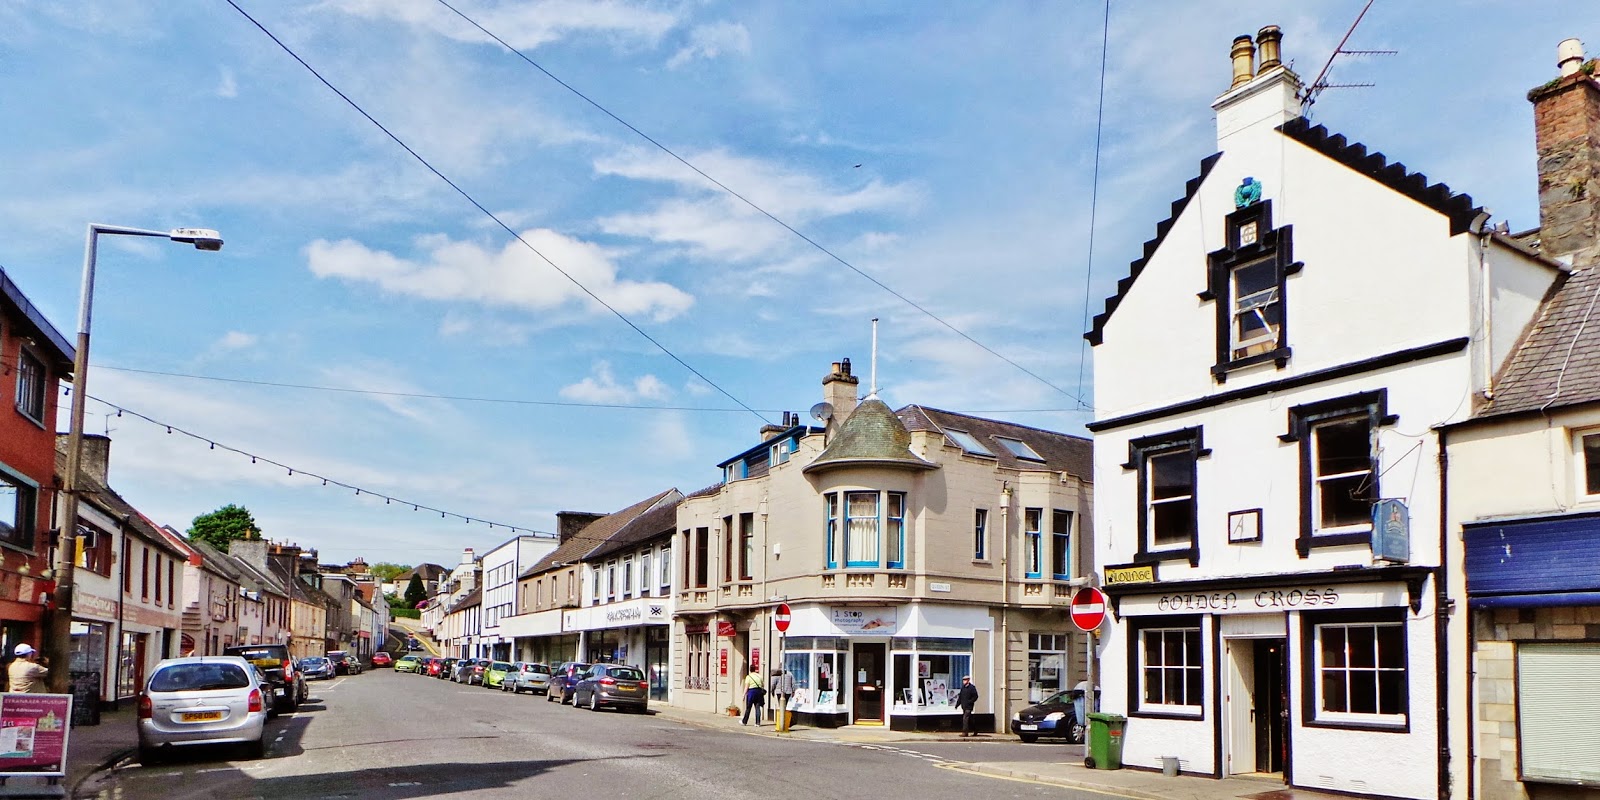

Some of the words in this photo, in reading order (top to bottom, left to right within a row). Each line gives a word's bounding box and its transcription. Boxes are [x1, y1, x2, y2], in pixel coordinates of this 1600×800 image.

[1111, 570, 1151, 582] LOUNGE
[1158, 591, 1237, 611] GOLDEN
[1254, 588, 1339, 607] CROSS
[843, 610, 863, 618] Stop
